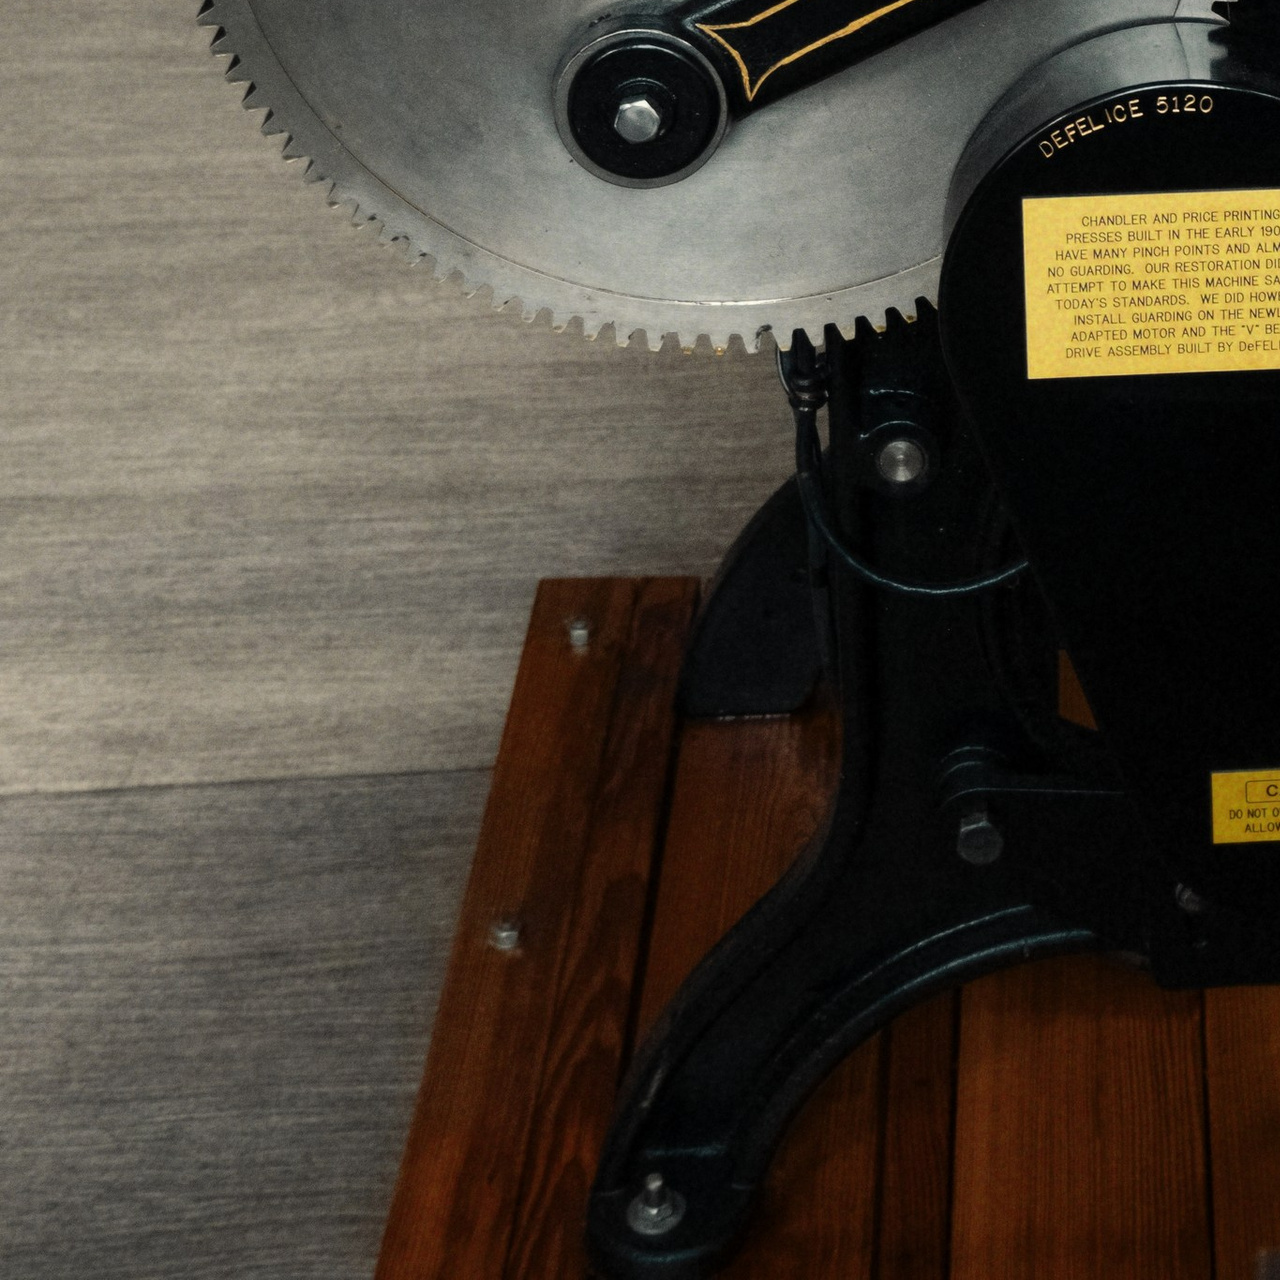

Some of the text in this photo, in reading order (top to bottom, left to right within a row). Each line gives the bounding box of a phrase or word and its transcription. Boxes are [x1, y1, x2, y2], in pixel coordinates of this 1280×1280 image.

[1038, 94, 1213, 158] DEFELICE 5120
[1081, 208, 1280, 227] CHANDLER AND PRICE PRINTING
[1066, 230, 1122, 244] PRESSES
[1127, 229, 1162, 242] BUILT
[1168, 229, 1180, 240] IN
[1186, 228, 1210, 239] THE
[1215, 226, 1255, 238] EARLY
[1055, 248, 1088, 260] HAVE
[1092, 247, 1127, 260] MANY
[1133, 246, 1170, 258] PINCH
[1174, 243, 1220, 256] POINTS
[1225, 242, 1250, 254] AND
[1047, 266, 1064, 278] NO
[1070, 263, 1134, 277] GUARDING.
[1144, 262, 1170, 274] OUR
[1174, 259, 1260, 272] RESTORATION
[1046, 281, 1104, 294] ATTEMPT
[1110, 280, 1127, 291] TO
[1132, 278, 1166, 290] MAKE
[1172, 277, 1200, 289] THIS
[1205, 275, 1259, 288] MACHINE
[1055, 297, 1107, 310] TODAY'S
[1112, 294, 1190, 308] STANDARDS.
[1200, 292, 1219, 304] WE
[1224, 292, 1244, 304] DID
[1074, 313, 1126, 325] INSTALL
[1131, 310, 1192, 324] GUARDING
[1197, 309, 1214, 321] ON
[1220, 308, 1244, 320] THE
[1070, 329, 1128, 342] ADAPTED
[1132, 327, 1176, 340] MOTOR
[1181, 326, 1206, 338] AND
[1211, 325, 1236, 336] THE
[1241, 324, 1260, 335] "V"
[1065, 346, 1101, 358] DRIVE
[1107, 344, 1172, 357] ASSEMBLY
[1177, 342, 1212, 354] BUILT
[1217, 341, 1233, 352] BY
[1229, 808, 1243, 820] DO
[1247, 808, 1267, 818] NOT
